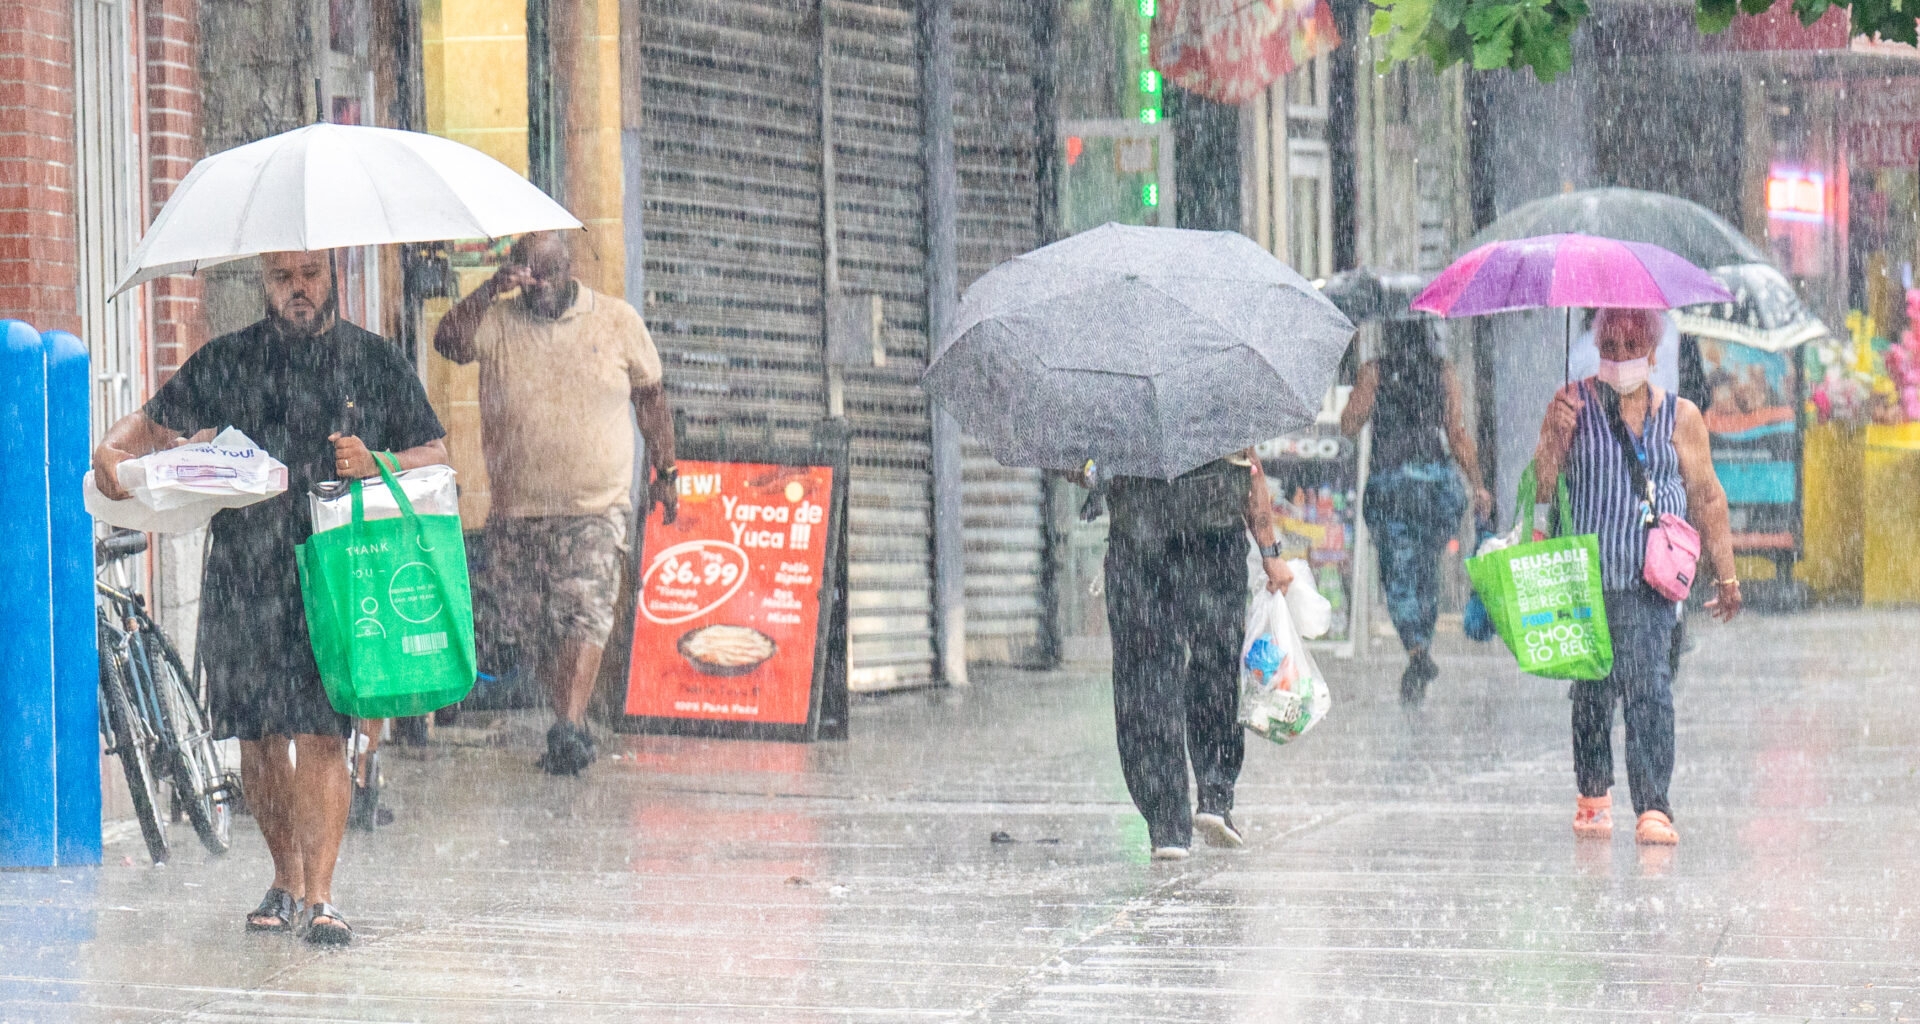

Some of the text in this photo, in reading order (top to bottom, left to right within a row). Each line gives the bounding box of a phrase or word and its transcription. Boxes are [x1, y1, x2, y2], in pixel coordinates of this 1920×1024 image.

[722, 495, 823, 524] Yaroa de
[730, 521, 785, 549] Yuca
[346, 543, 389, 556] THANK
[1510, 547, 1588, 573] REUSABLE
[352, 568, 373, 578] OU
[660, 556, 739, 586] $6.99
[1528, 645, 1553, 664] TO
